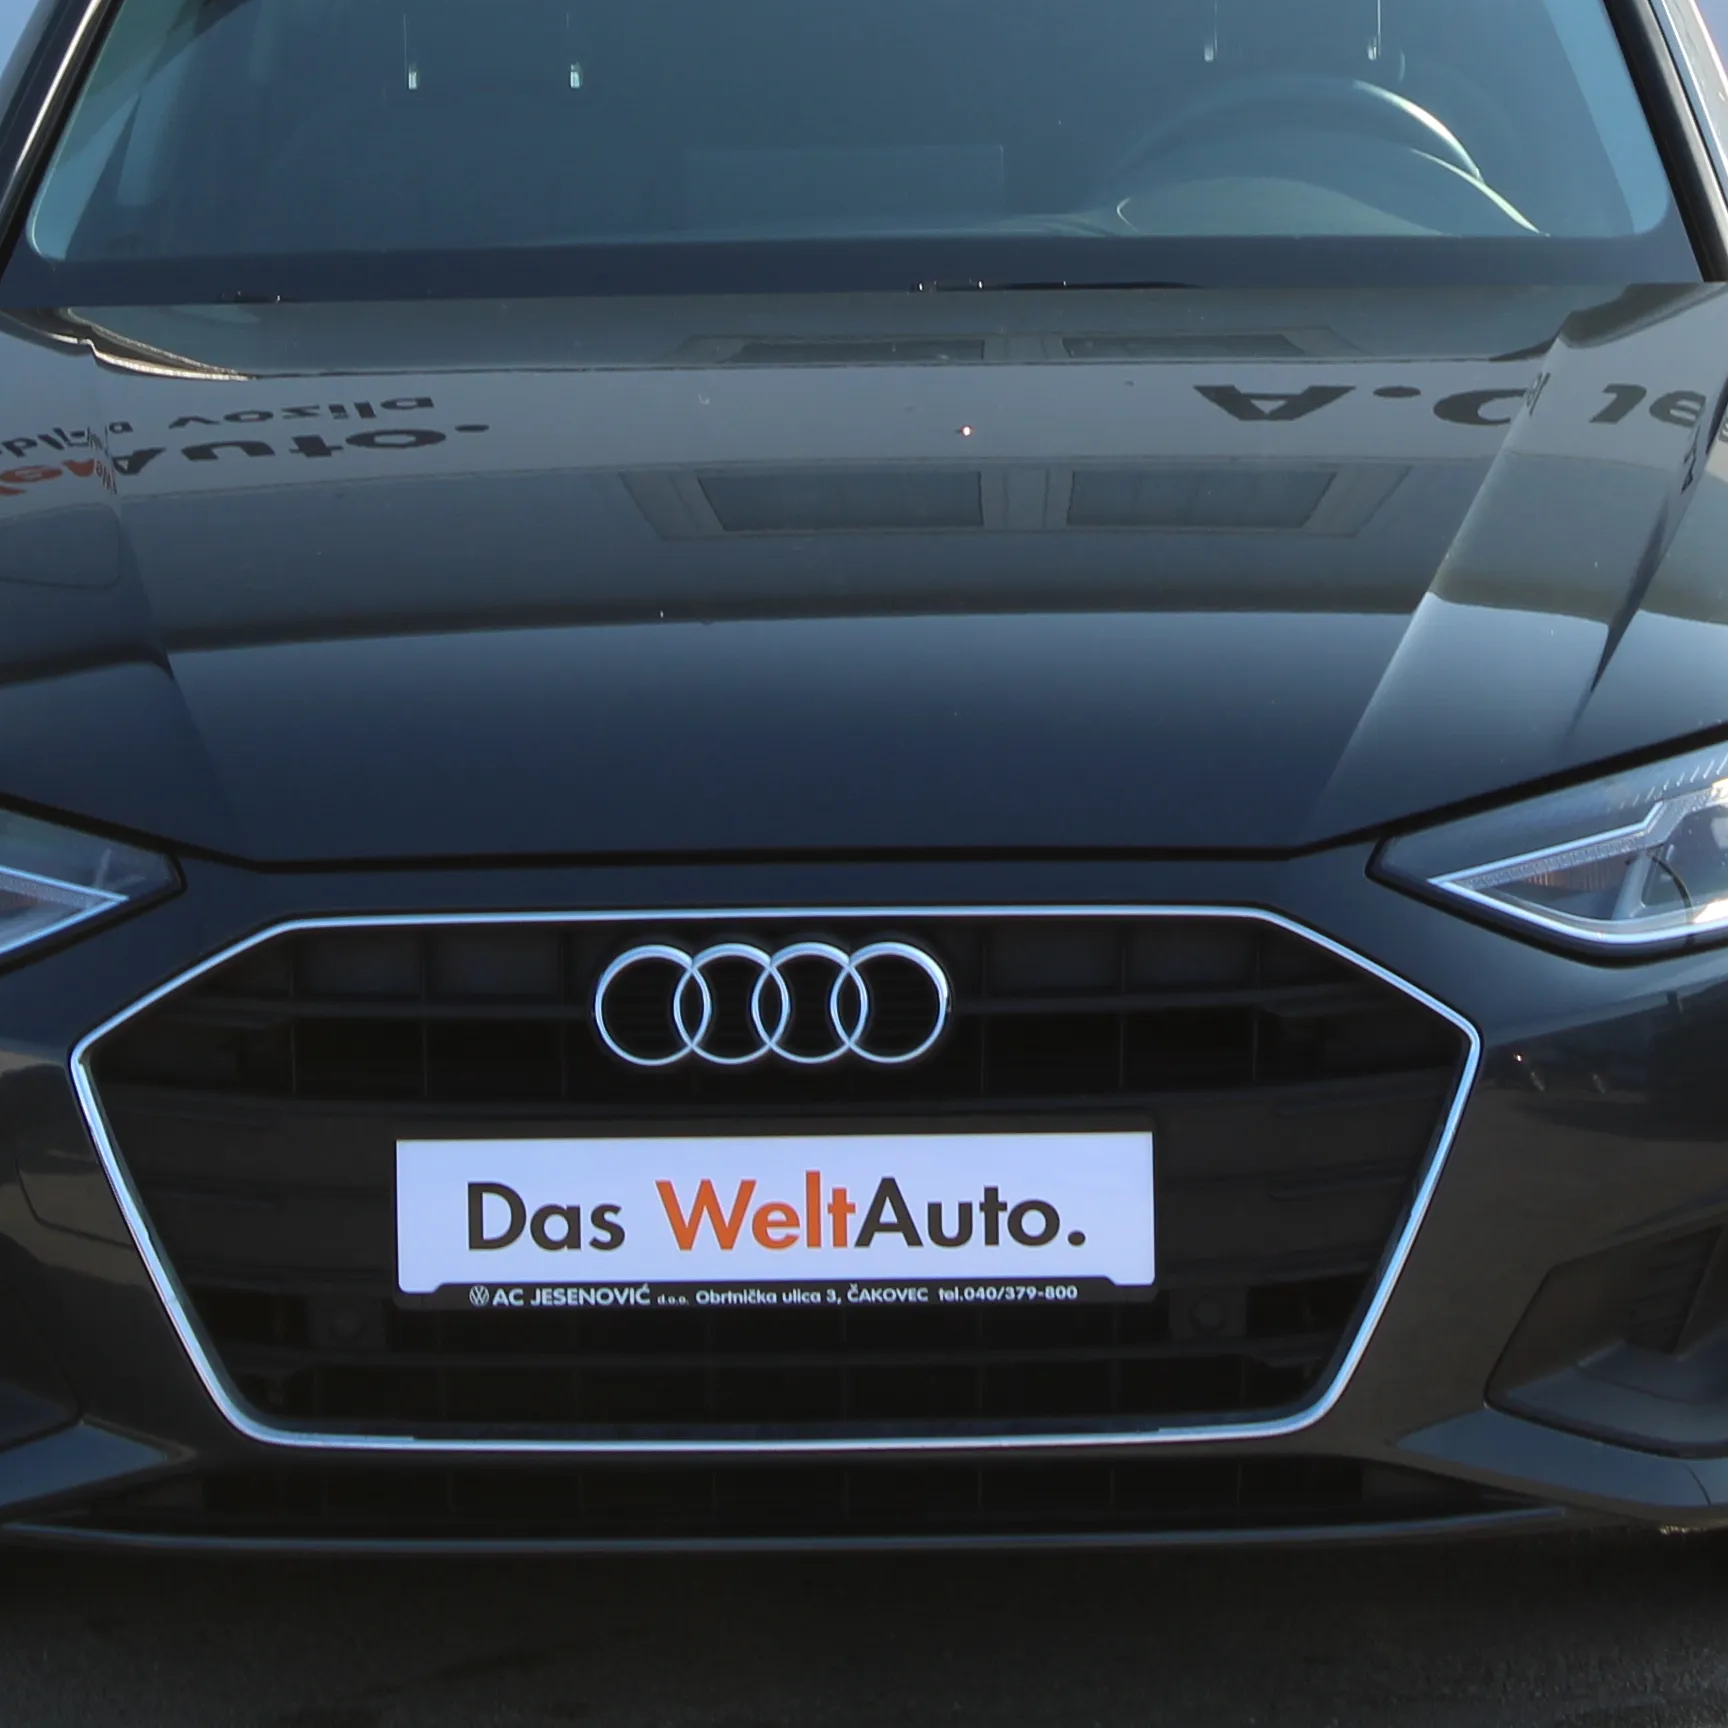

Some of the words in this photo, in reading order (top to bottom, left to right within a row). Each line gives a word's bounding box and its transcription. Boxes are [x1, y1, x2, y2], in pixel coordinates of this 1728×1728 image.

[467, 1180, 626, 1252] Das
[655, 1170, 1087, 1251] WeltAuto.
[492, 1288, 525, 1306] AC
[530, 1282, 651, 1306] JESENOVIĆ
[695, 1287, 778, 1305] Obrtnička
[782, 1288, 822, 1304] ulica
[826, 1288, 842, 1306] 3,
[846, 1282, 929, 1303] ČAKOVEC
[938, 1285, 1079, 1303] tel.040/379-800
